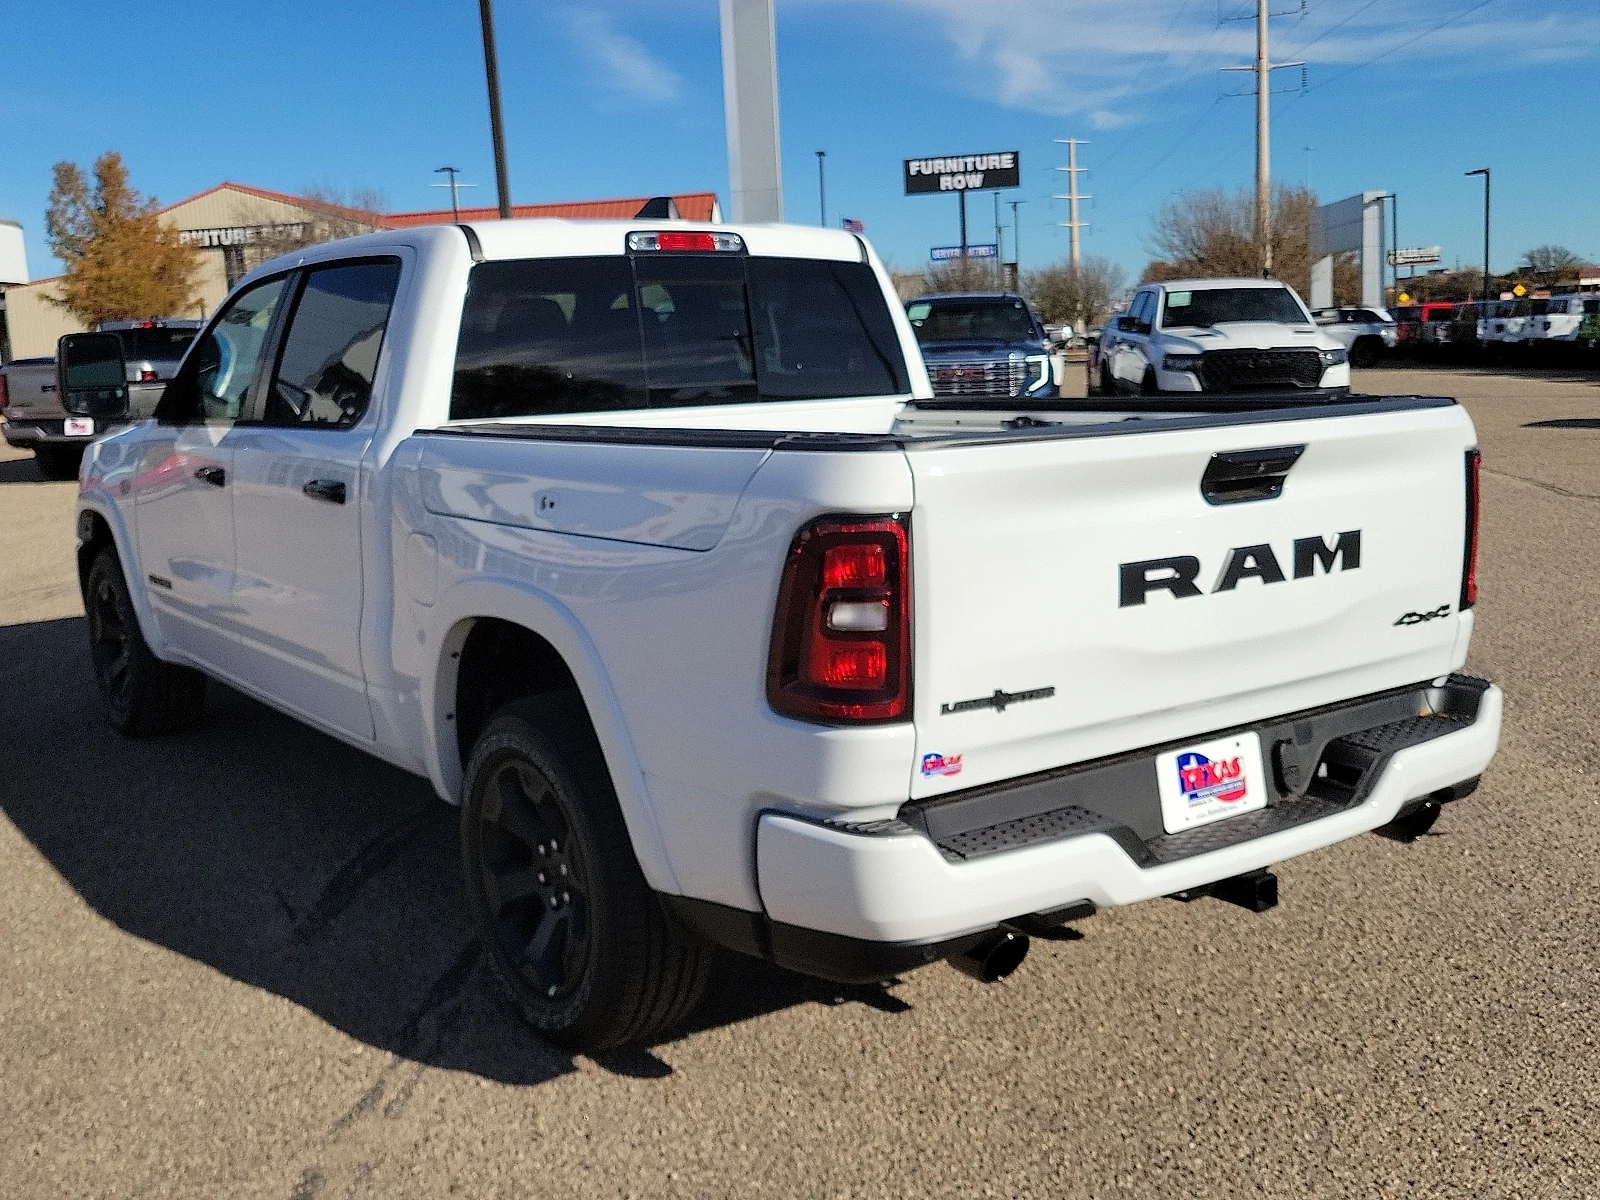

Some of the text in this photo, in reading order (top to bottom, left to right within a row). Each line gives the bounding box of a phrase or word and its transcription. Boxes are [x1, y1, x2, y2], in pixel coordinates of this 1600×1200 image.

[909, 153, 1015, 176] FURNITURE
[939, 173, 985, 191] ROW
[1118, 529, 1362, 608] RAM
[1179, 756, 1241, 793] TEXAS
